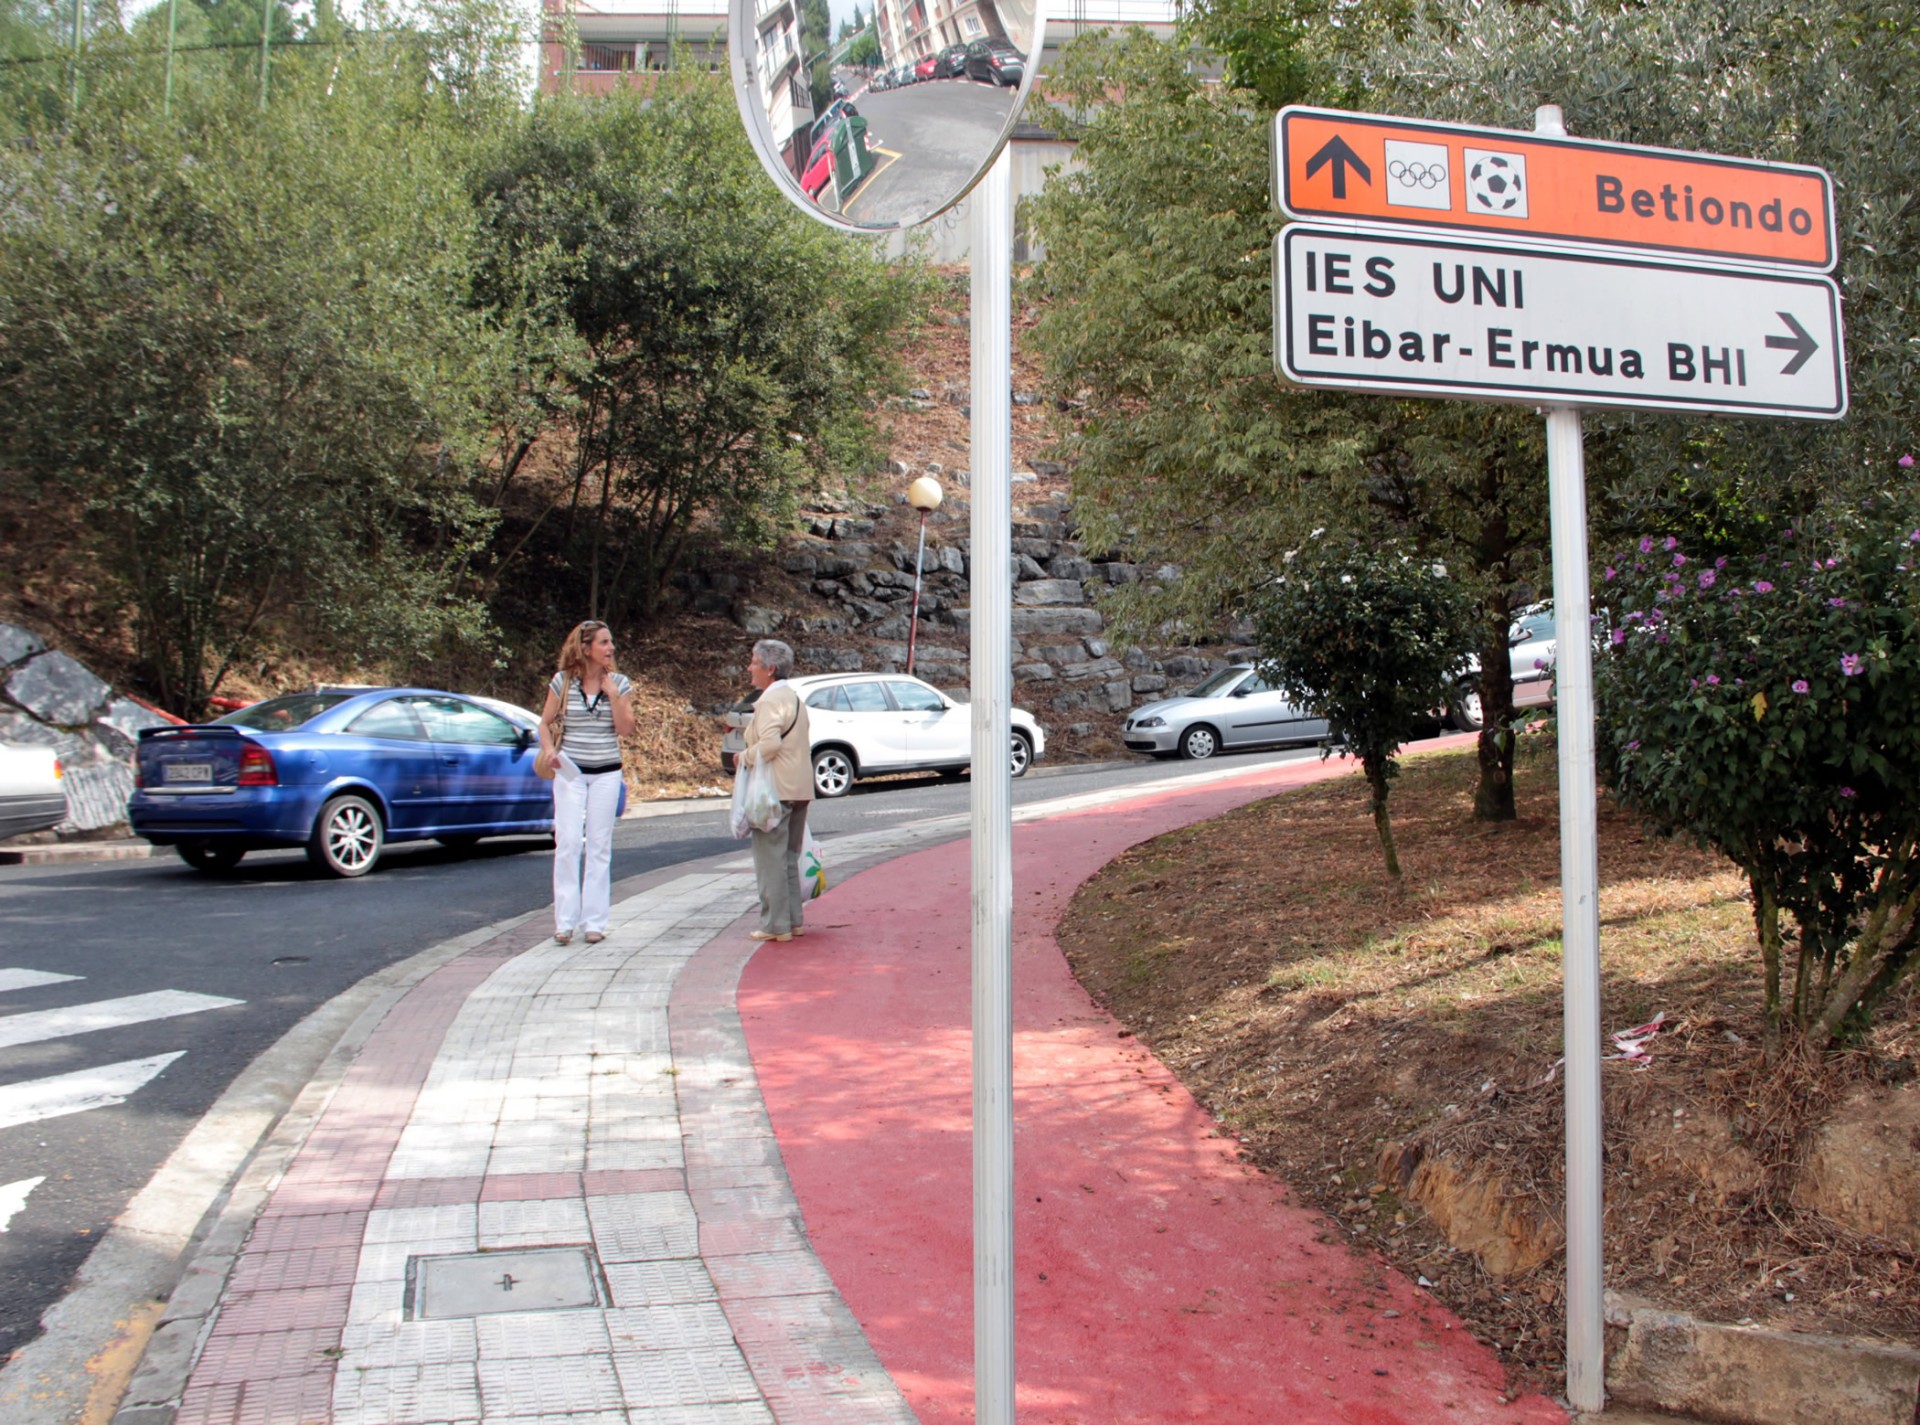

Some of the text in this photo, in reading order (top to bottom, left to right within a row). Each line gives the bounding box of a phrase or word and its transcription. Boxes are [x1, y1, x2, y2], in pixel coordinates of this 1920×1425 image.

[1596, 175, 1812, 235] Betiondo
[1306, 251, 1524, 310] IES UNI
[1308, 313, 1747, 387] Eibar-Ermua BHI
